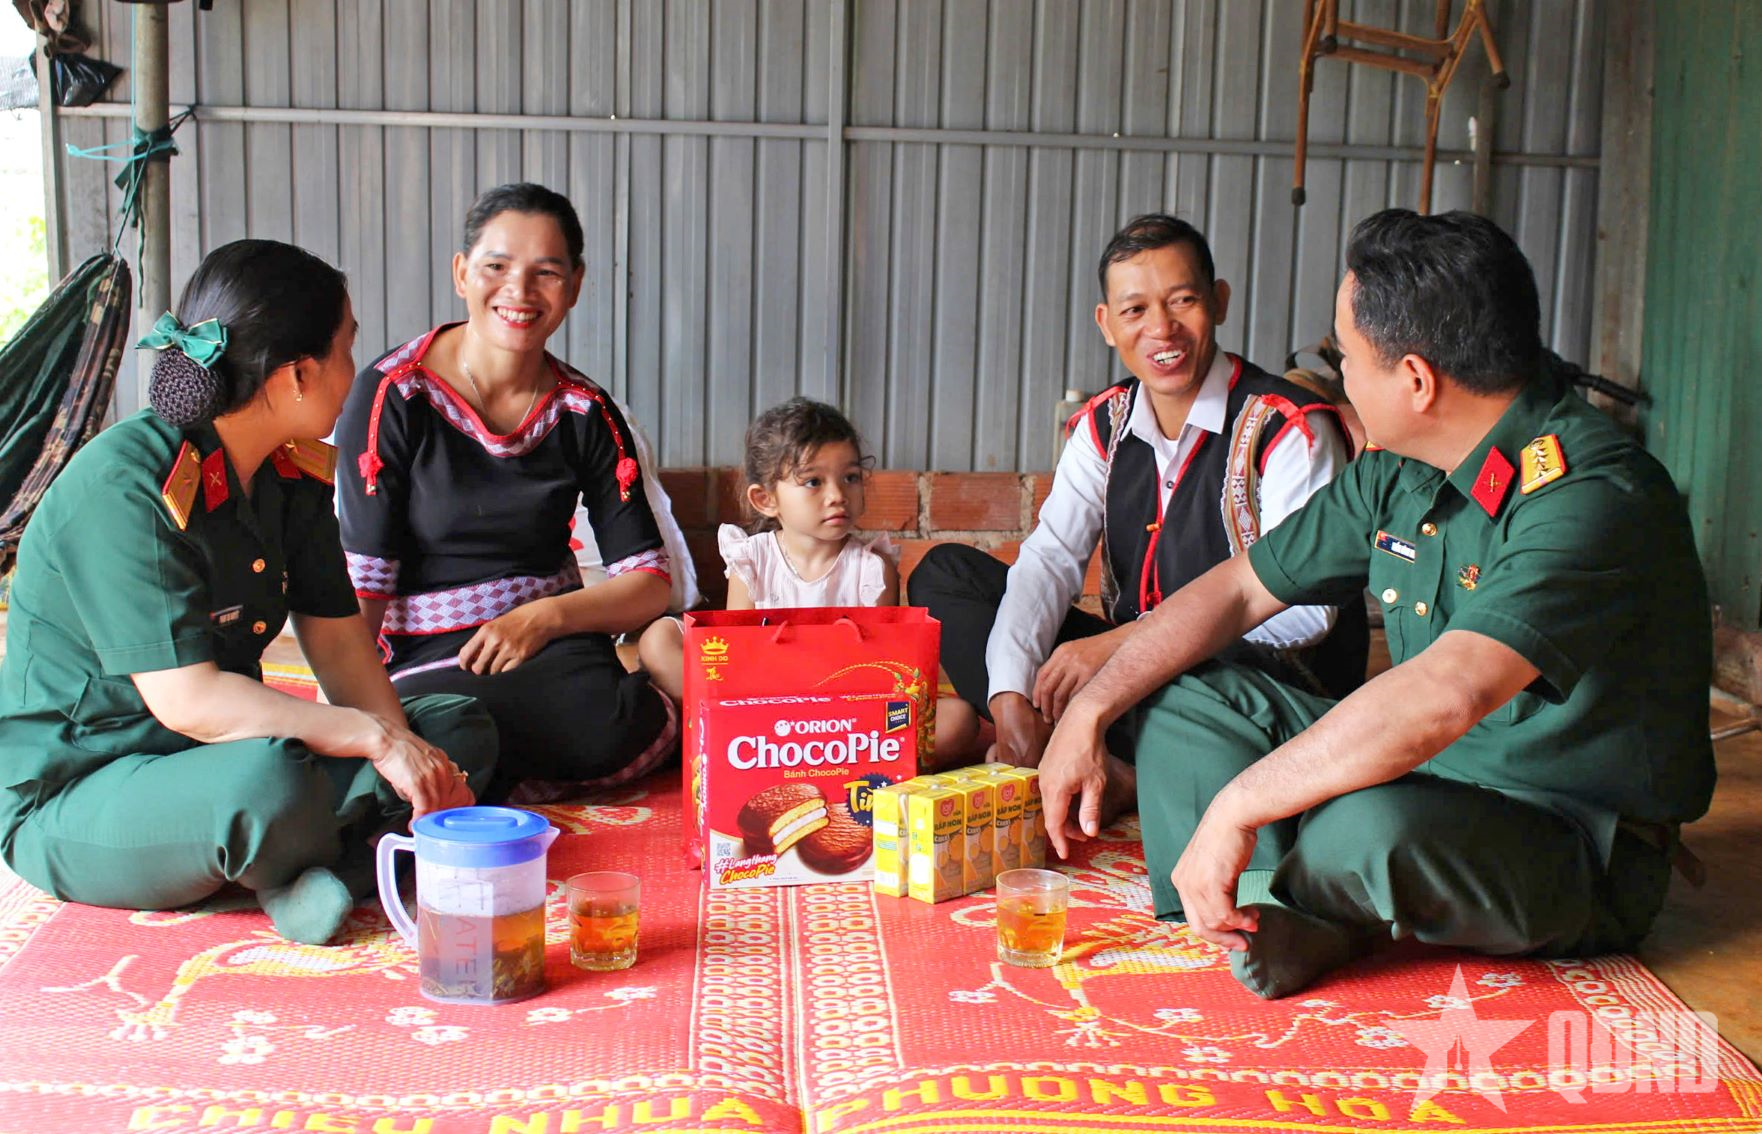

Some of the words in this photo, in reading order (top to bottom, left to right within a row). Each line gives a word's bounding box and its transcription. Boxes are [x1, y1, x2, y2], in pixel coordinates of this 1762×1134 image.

[888, 707, 907, 717] SMART
[795, 719, 852, 734] ORION
[727, 730, 900, 770] ChocoPie
[784, 768, 807, 778] Bánh
[808, 767, 850, 777] ChocoPie
[720, 863, 776, 885] ChocoPie
[489, 1097, 763, 1134] NHUA
[815, 1074, 1217, 1133] PHUONG
[1264, 1089, 1467, 1125] HOA
